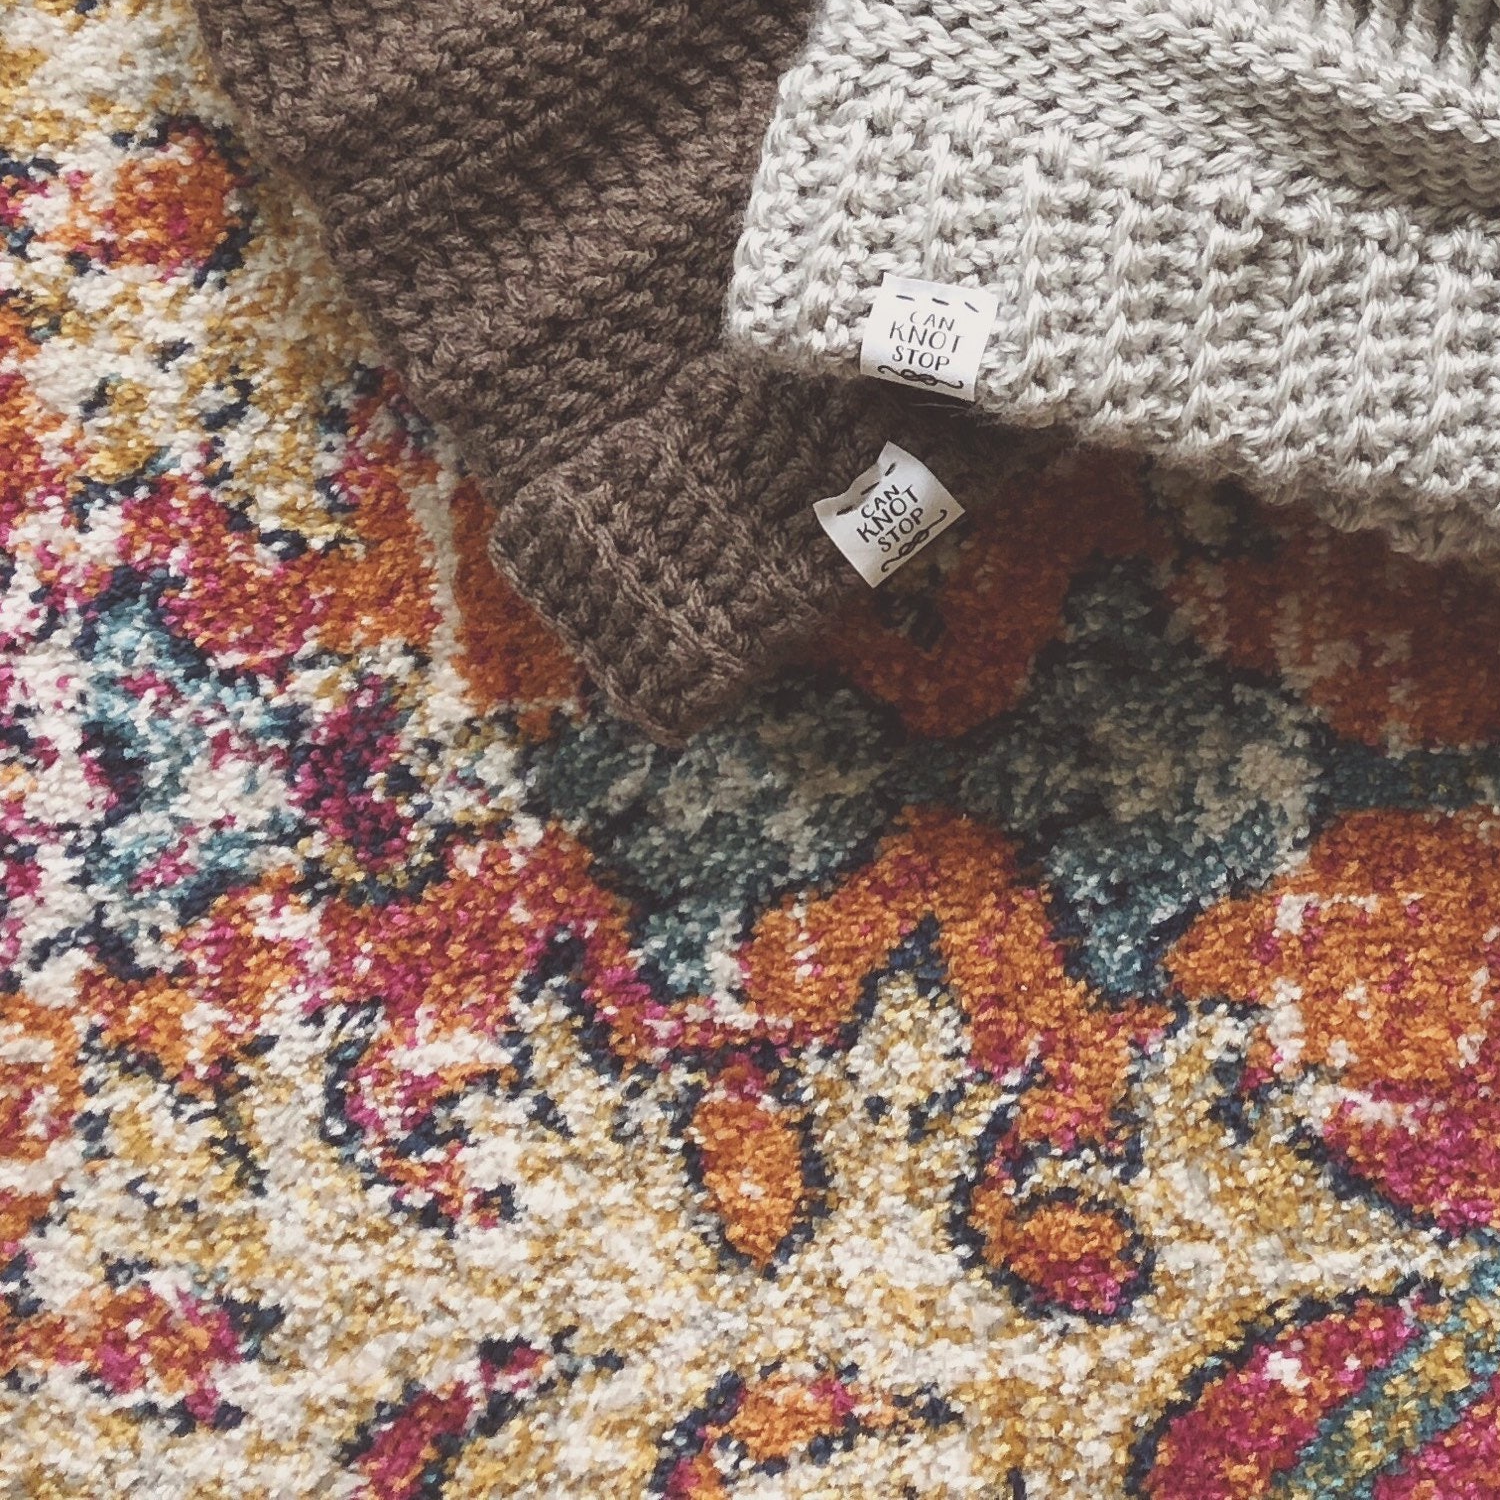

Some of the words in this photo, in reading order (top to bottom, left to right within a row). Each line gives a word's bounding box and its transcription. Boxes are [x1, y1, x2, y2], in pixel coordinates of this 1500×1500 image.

[889, 321, 965, 353] KNOT
[909, 311, 955, 331] CAN
[892, 345, 950, 371] STOP
[856, 484, 918, 543] KNOT
[861, 484, 900, 519] CAN
[878, 507, 924, 553] STOP
